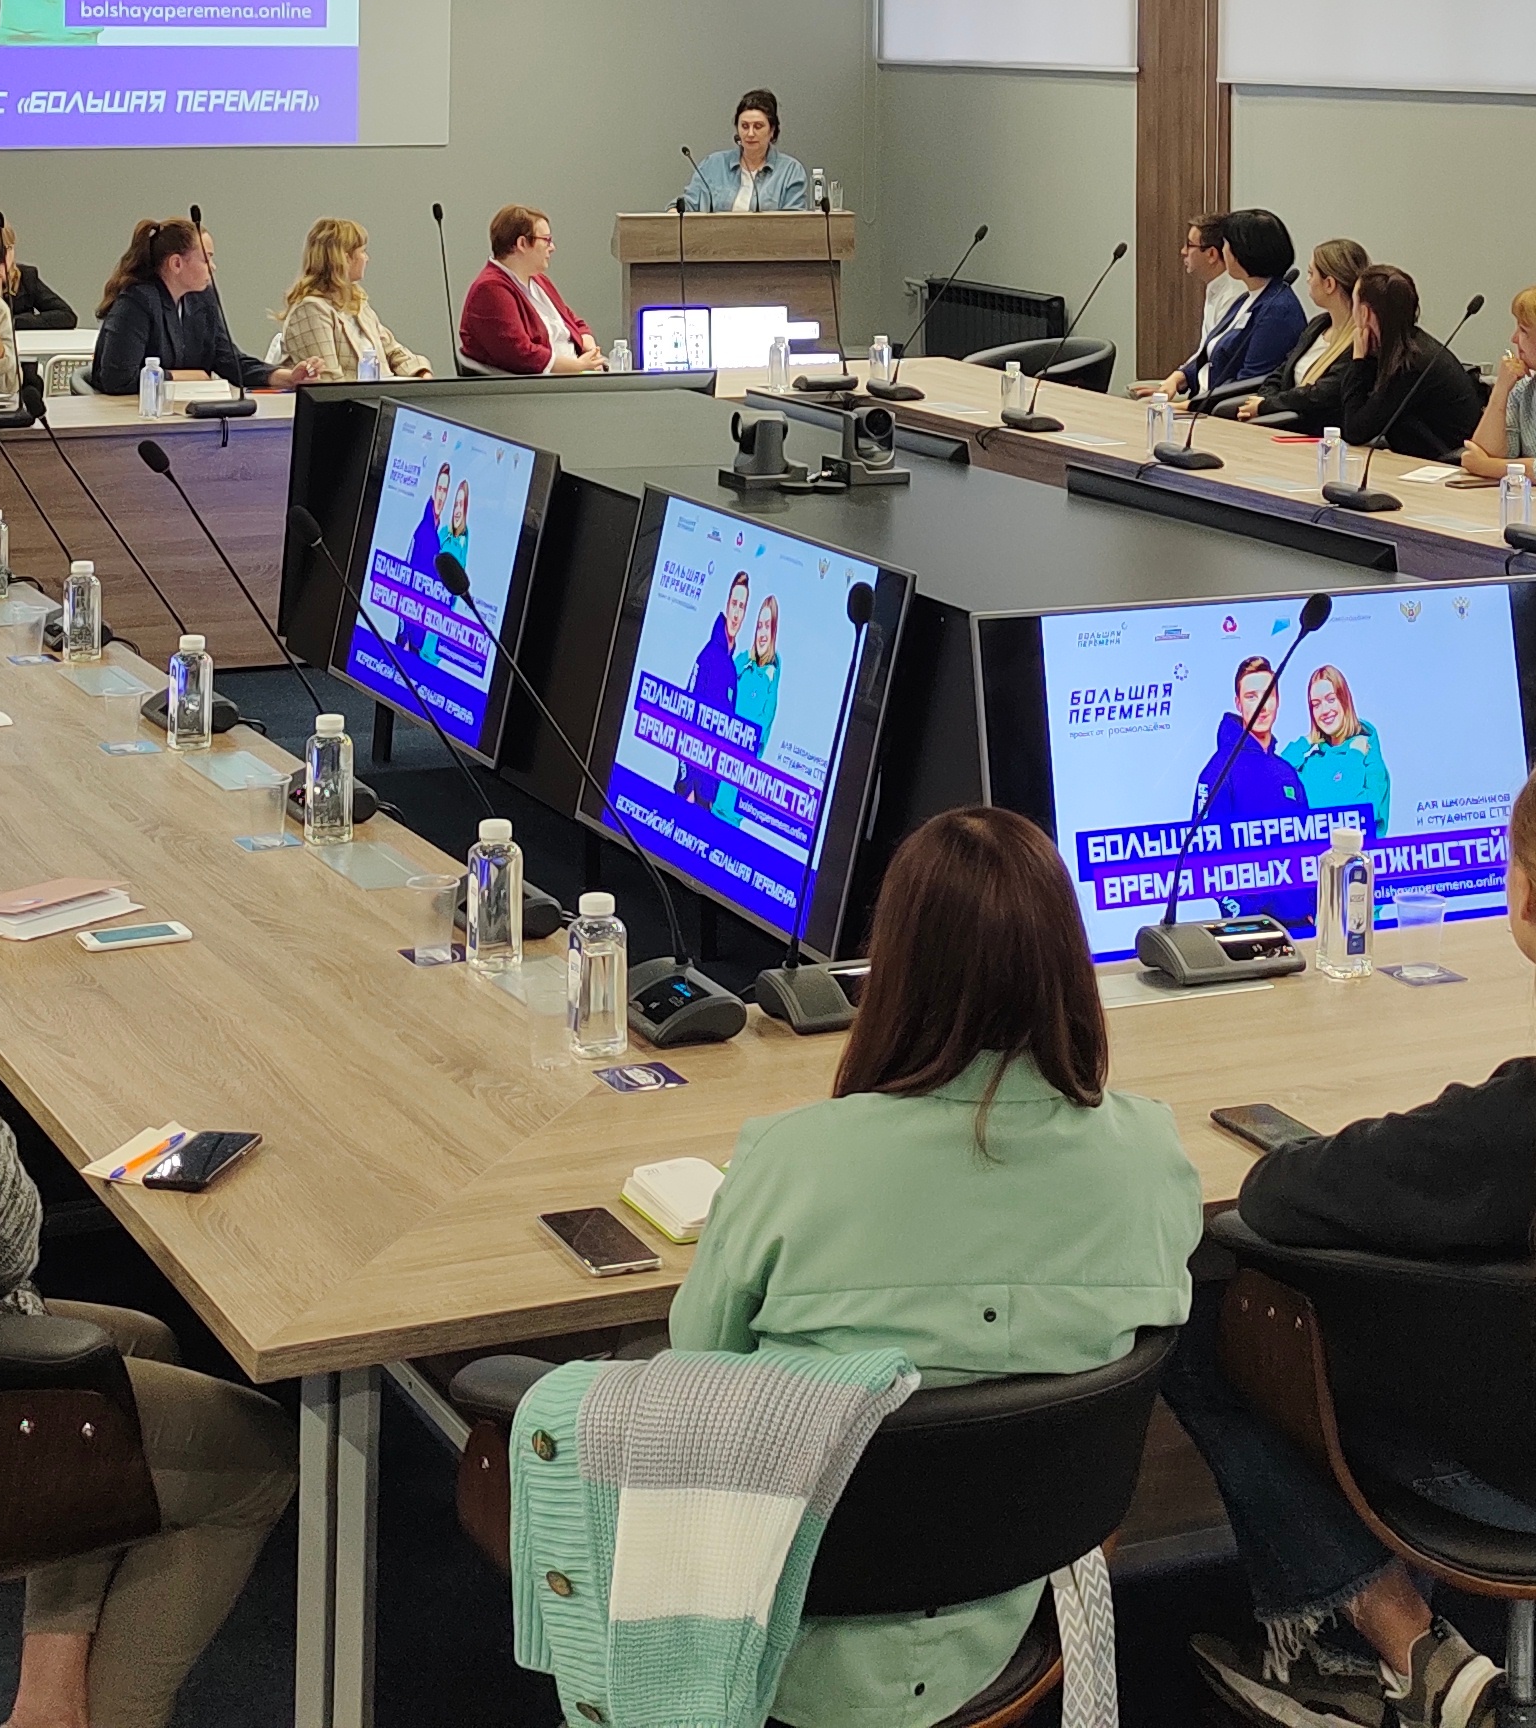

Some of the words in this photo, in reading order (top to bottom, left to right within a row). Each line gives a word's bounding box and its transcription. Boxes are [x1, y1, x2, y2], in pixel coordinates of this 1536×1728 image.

[80, 0, 312, 22] bolshayaperemena.online
[17, 90, 166, 114] «БОЛЬШАЯ
[175, 89, 320, 113] ПЕРЕМЕНА»
[640, 676, 696, 721] БОЛЬШАЯ
[1070, 682, 1173, 706] БОЛЬШАЯ
[1069, 700, 1171, 724] ПЕРЕМЕНА
[638, 712, 676, 750] ВРЕМЯ
[676, 730, 717, 770] НОВЫХ
[1103, 869, 1195, 905] ВРЕМЯ
[1203, 859, 1293, 894] НОВЫХ
